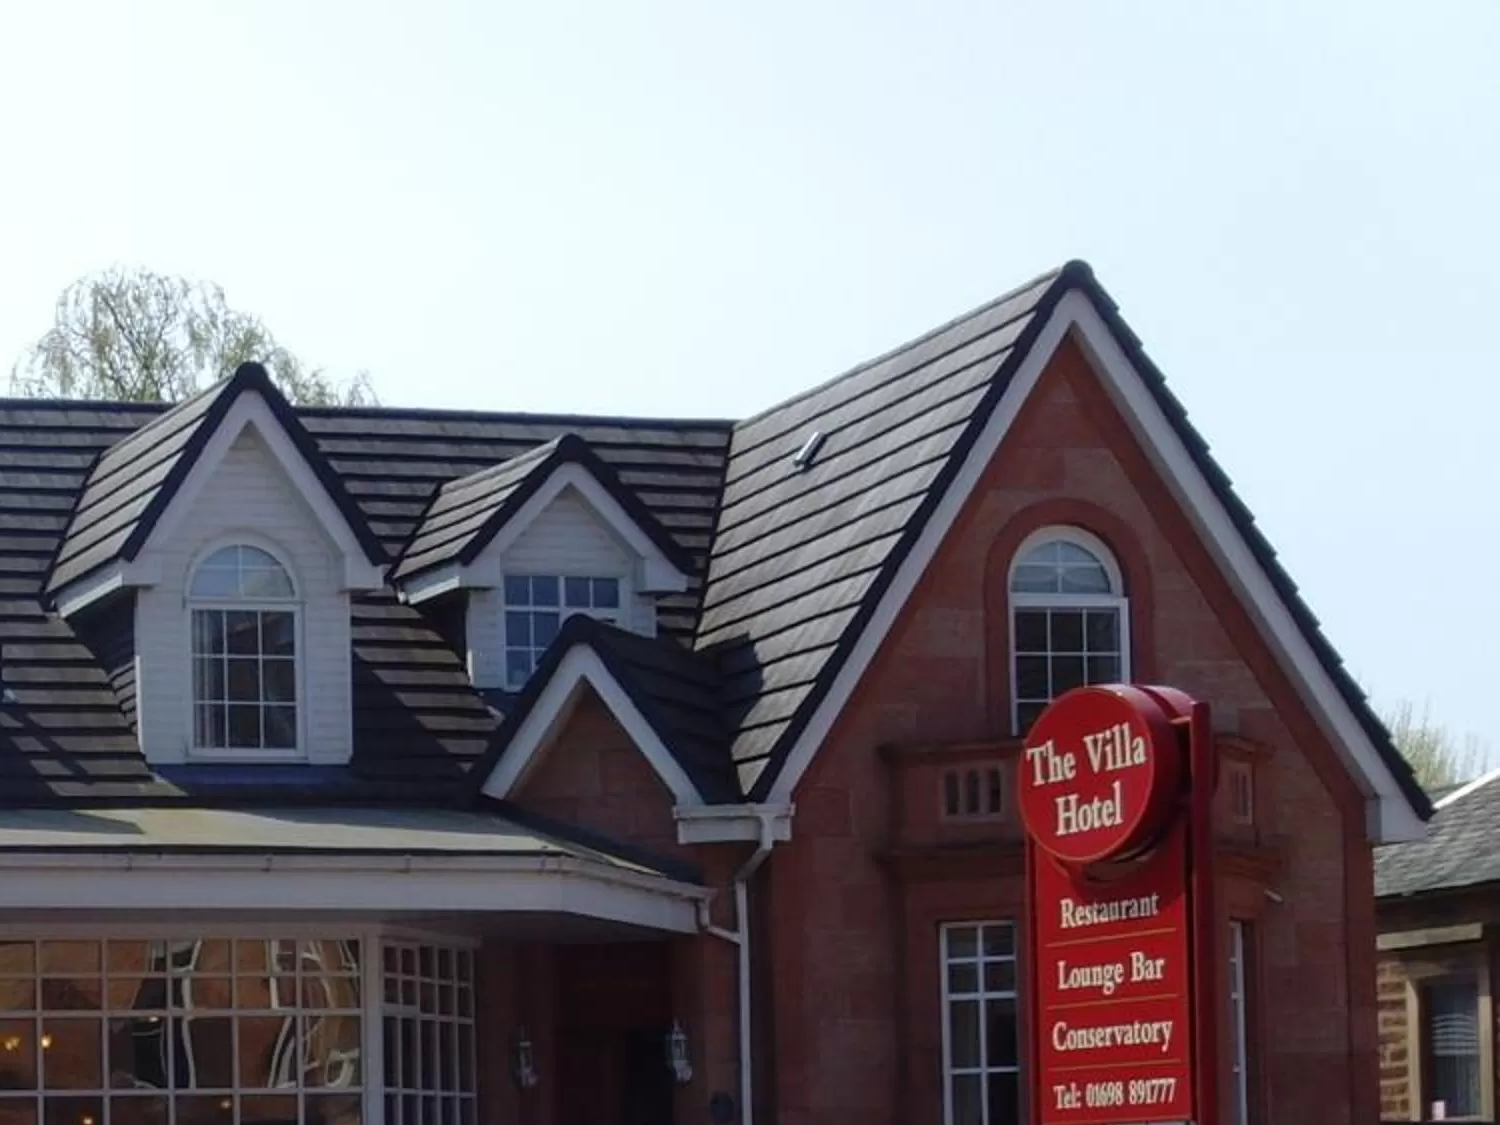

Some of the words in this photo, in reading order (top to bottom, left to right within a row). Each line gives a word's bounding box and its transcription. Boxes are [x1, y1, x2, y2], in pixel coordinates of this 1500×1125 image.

[1027, 740, 1076, 787] The
[1084, 722, 1148, 774] Villa
[1054, 781, 1124, 836] Hotel
[1060, 893, 1160, 928] Restaurant
[1057, 960, 1124, 995] Lounge
[1130, 951, 1165, 982] Bar
[1052, 1019, 1174, 1052] Conservatory
[1053, 1082, 1081, 1109] Tel:
[1086, 1080, 1124, 1108] 01698
[1129, 1078, 1177, 1105] 891777
